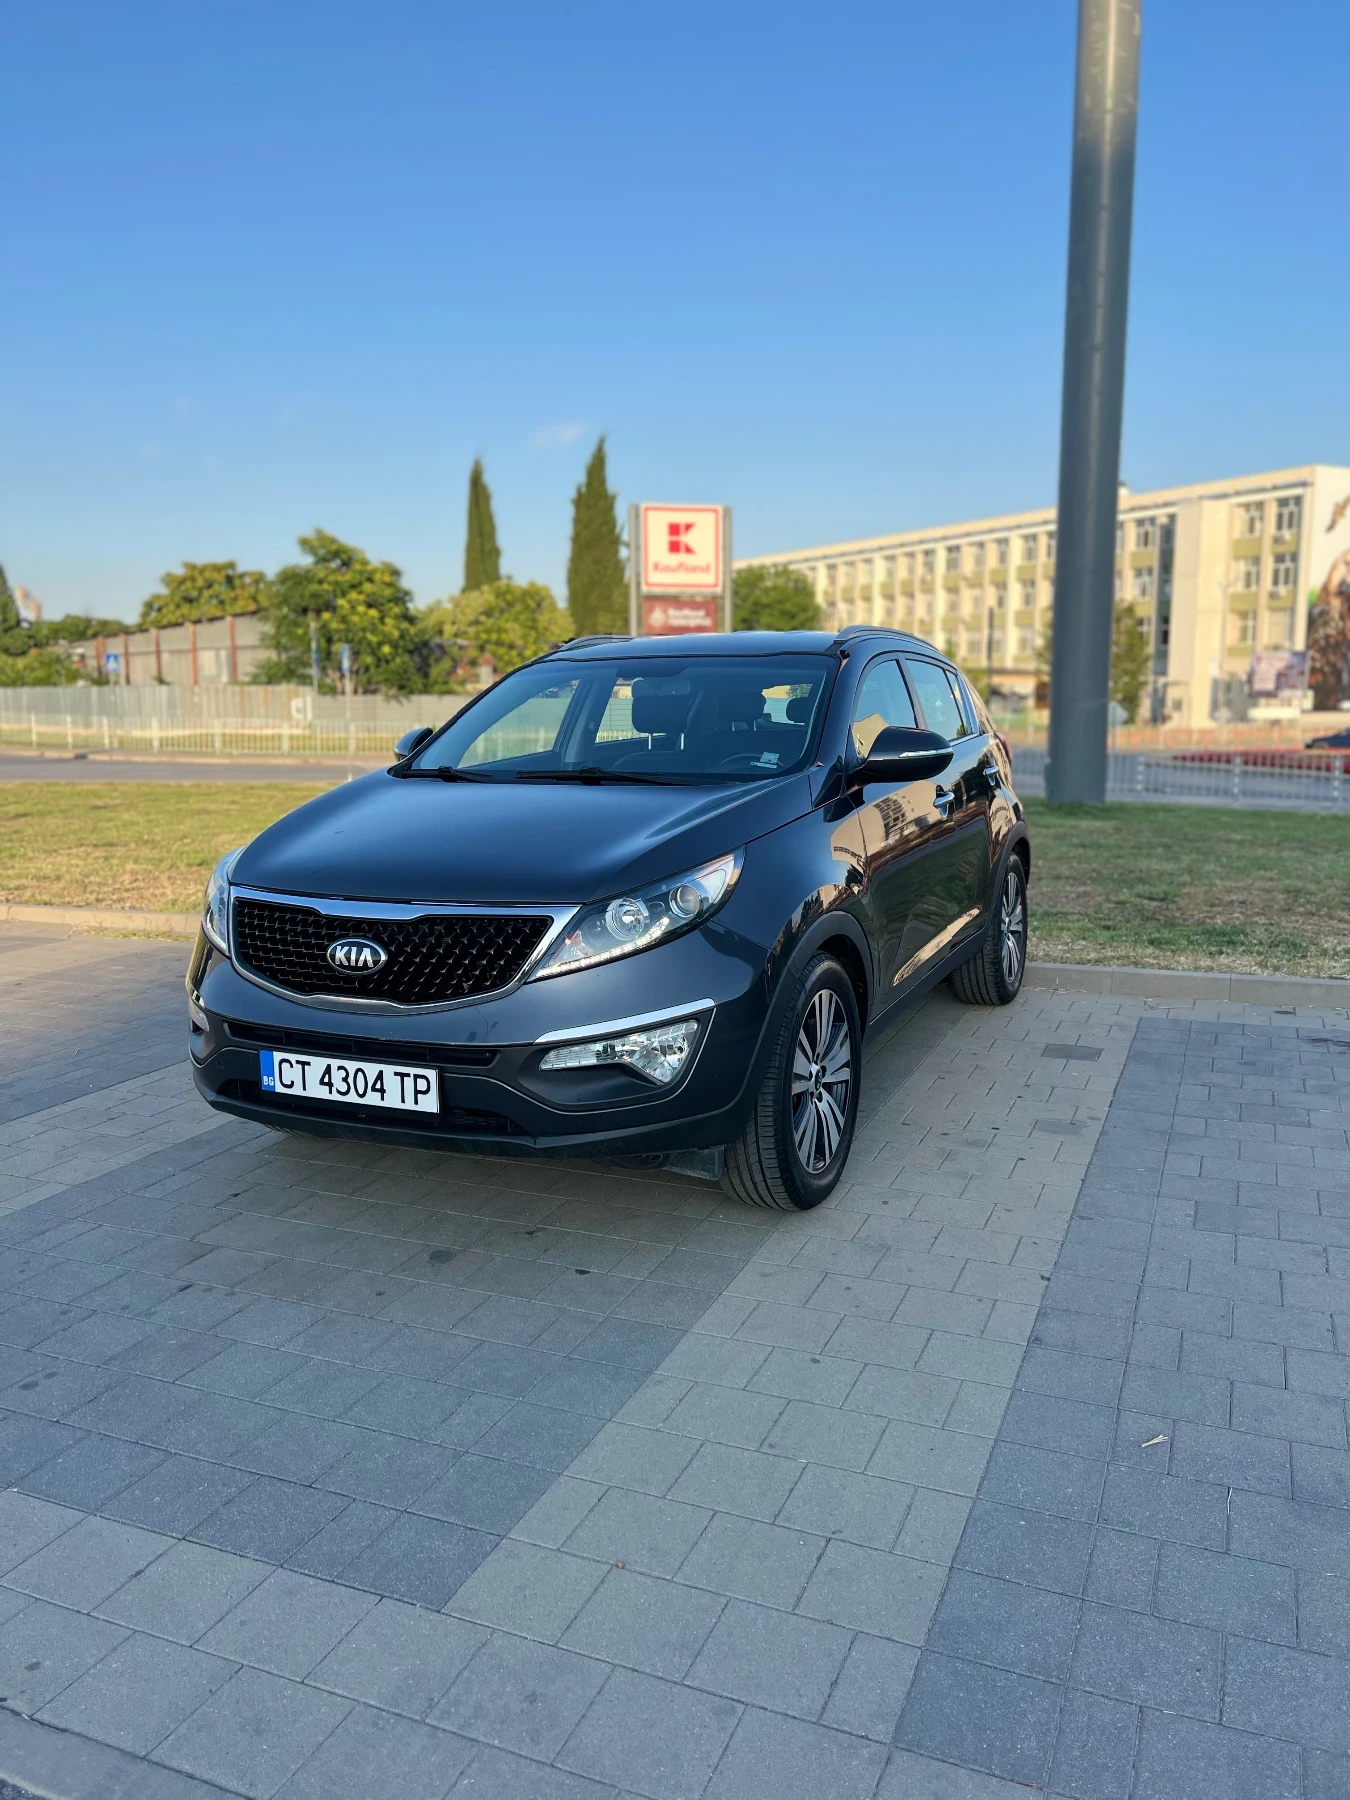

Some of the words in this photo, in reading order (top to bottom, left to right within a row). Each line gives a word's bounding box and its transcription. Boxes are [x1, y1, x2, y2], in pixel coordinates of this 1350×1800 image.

[668, 522, 696, 555] K
[335, 945, 374, 968] KIA
[263, 1075, 275, 1086] BG
[278, 1058, 311, 1091] CT
[319, 1063, 387, 1101] 4304
[394, 1071, 431, 1106] TP
